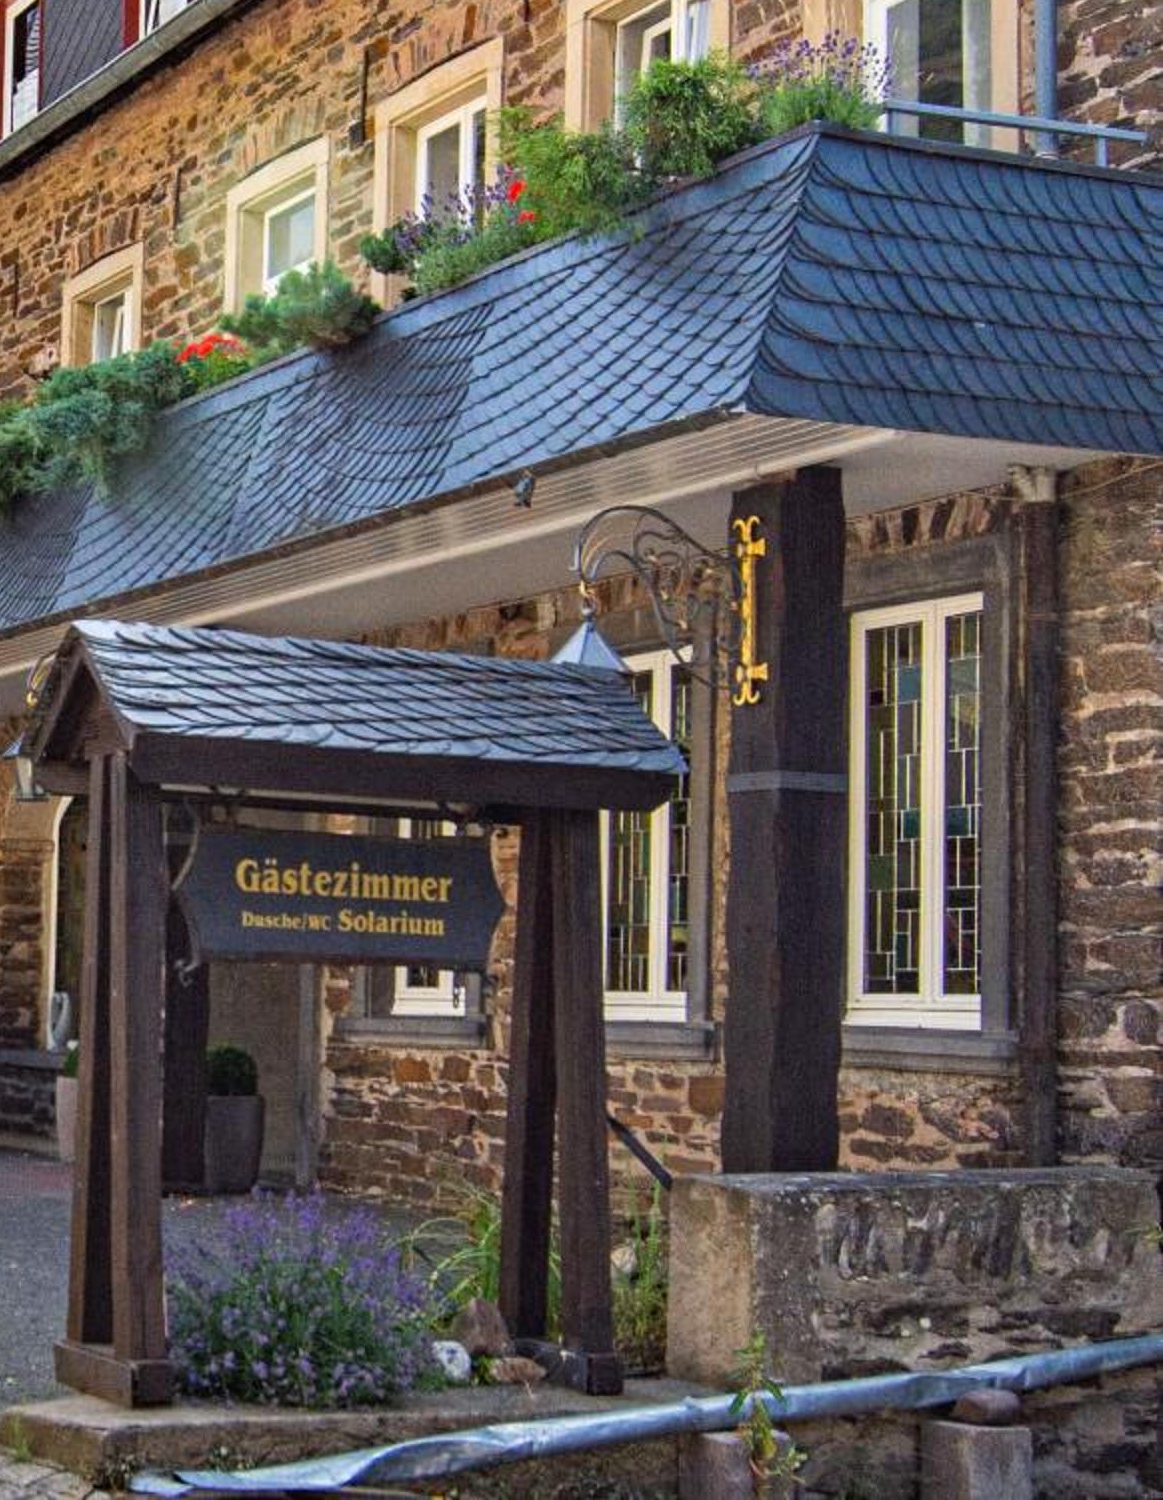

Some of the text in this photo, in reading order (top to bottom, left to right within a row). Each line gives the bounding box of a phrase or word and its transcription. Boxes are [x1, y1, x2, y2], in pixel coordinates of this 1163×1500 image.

[235, 857, 453, 902] Gästezimmer
[241, 908, 445, 936] Dusche/WC Solarium
